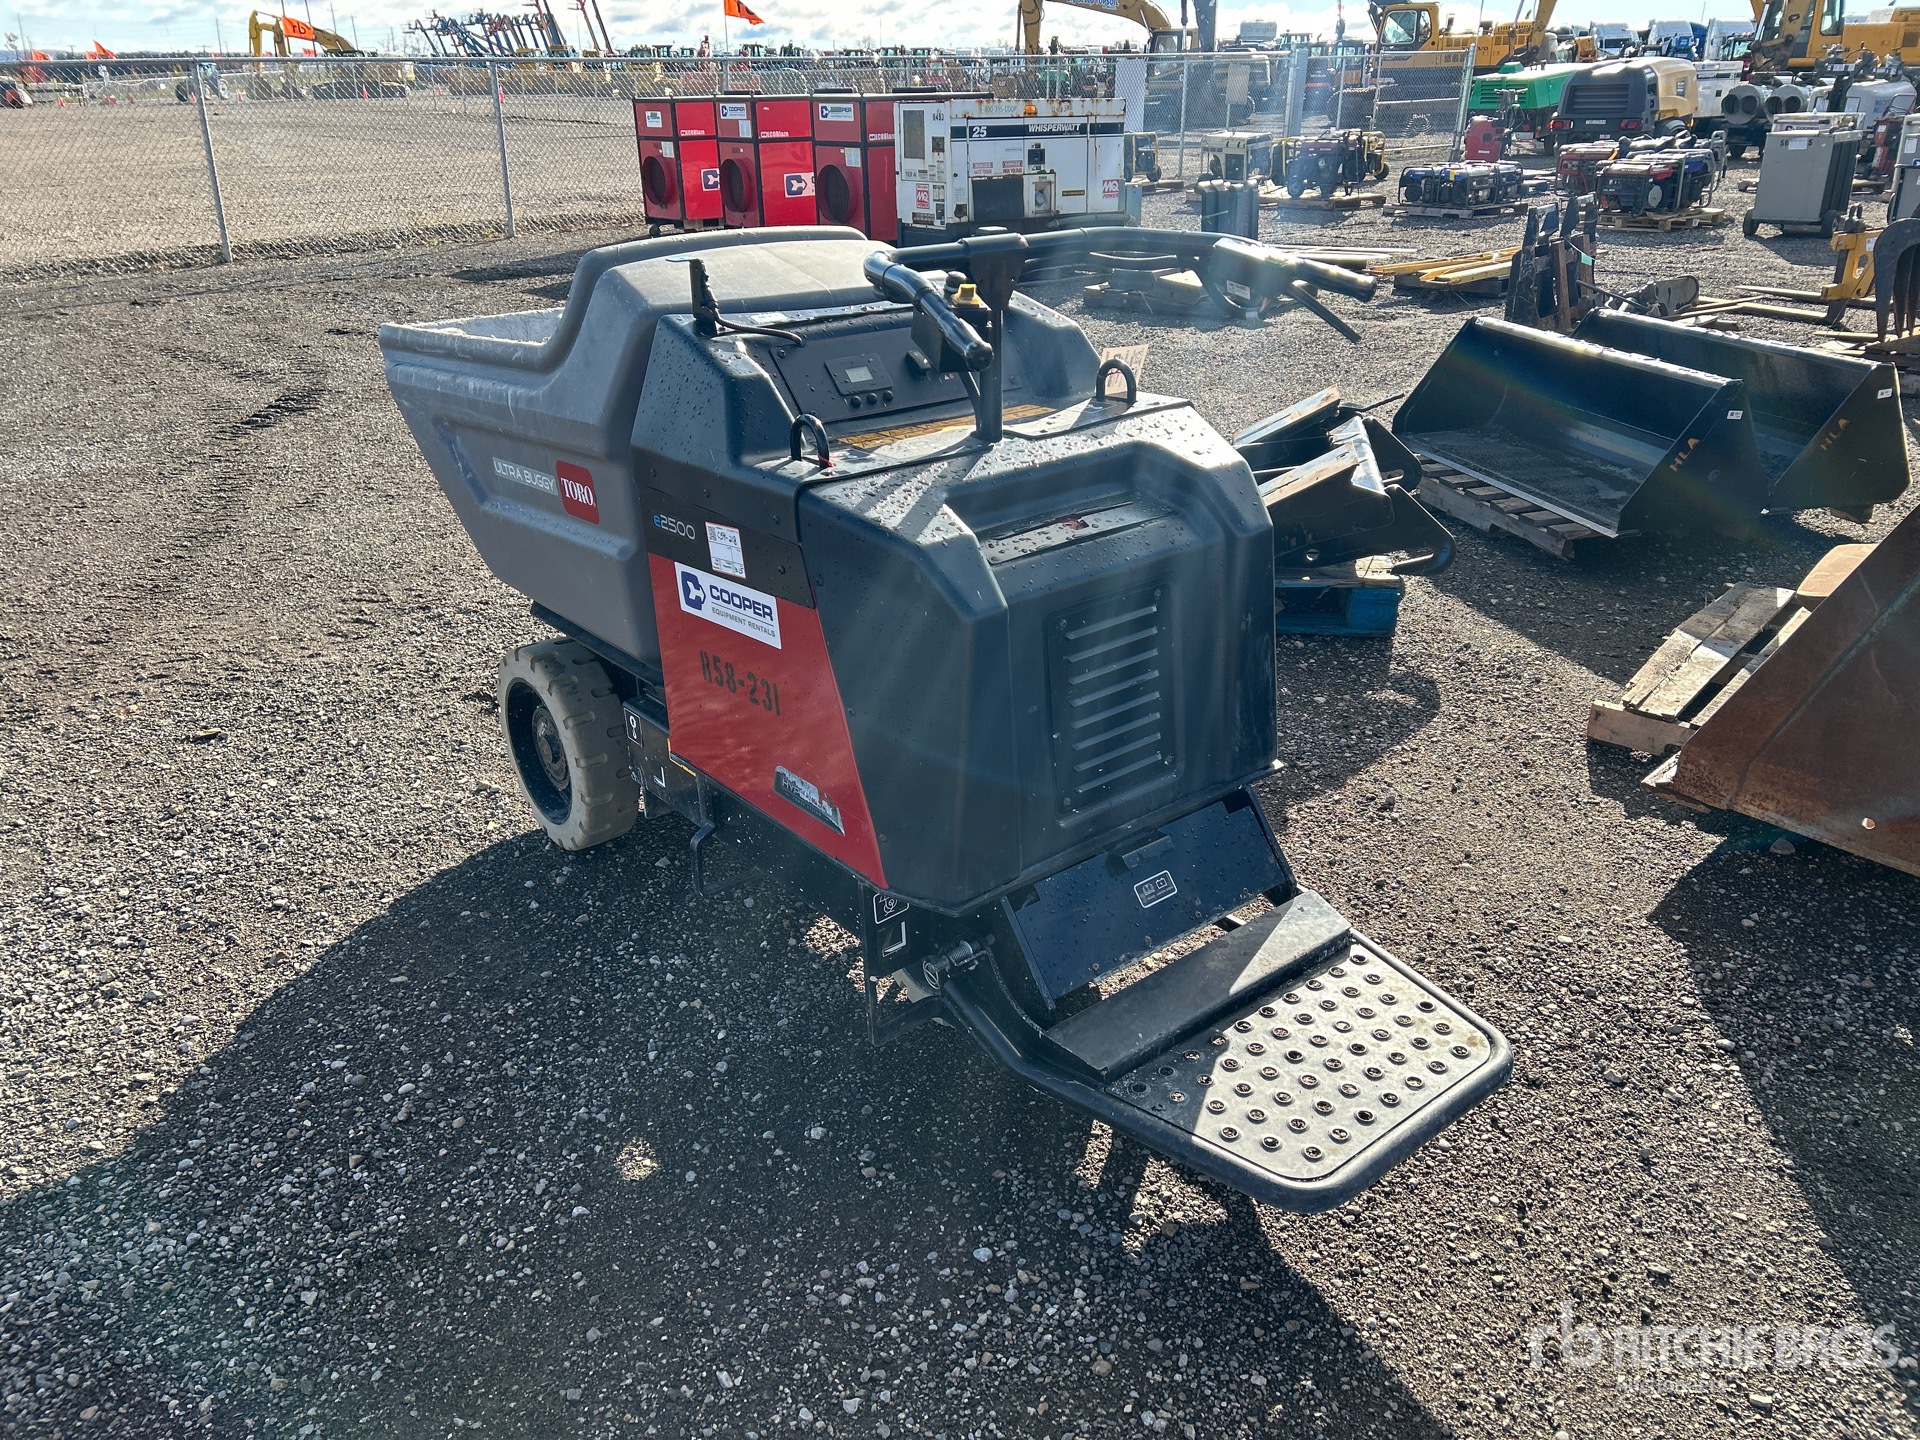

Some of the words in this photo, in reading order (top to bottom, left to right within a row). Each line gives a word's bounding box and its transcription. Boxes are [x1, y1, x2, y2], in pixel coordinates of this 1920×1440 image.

[972, 126, 988, 138] 25
[1028, 123, 1081, 133] WHISPERWATT
[1102, 180, 1119, 193] MQ
[1820, 418, 1849, 450] HLA
[1669, 438, 1700, 472] HLA
[493, 460, 523, 481] ULTRA
[523, 470, 556, 492] BUGGY
[561, 477, 594, 506] TORO
[653, 514, 696, 540] e2500
[709, 584, 774, 621] COOPER
[711, 607, 746, 626] EQUIPMENT
[748, 621, 776, 638] RENTALS
[700, 649, 781, 716] R58-231
